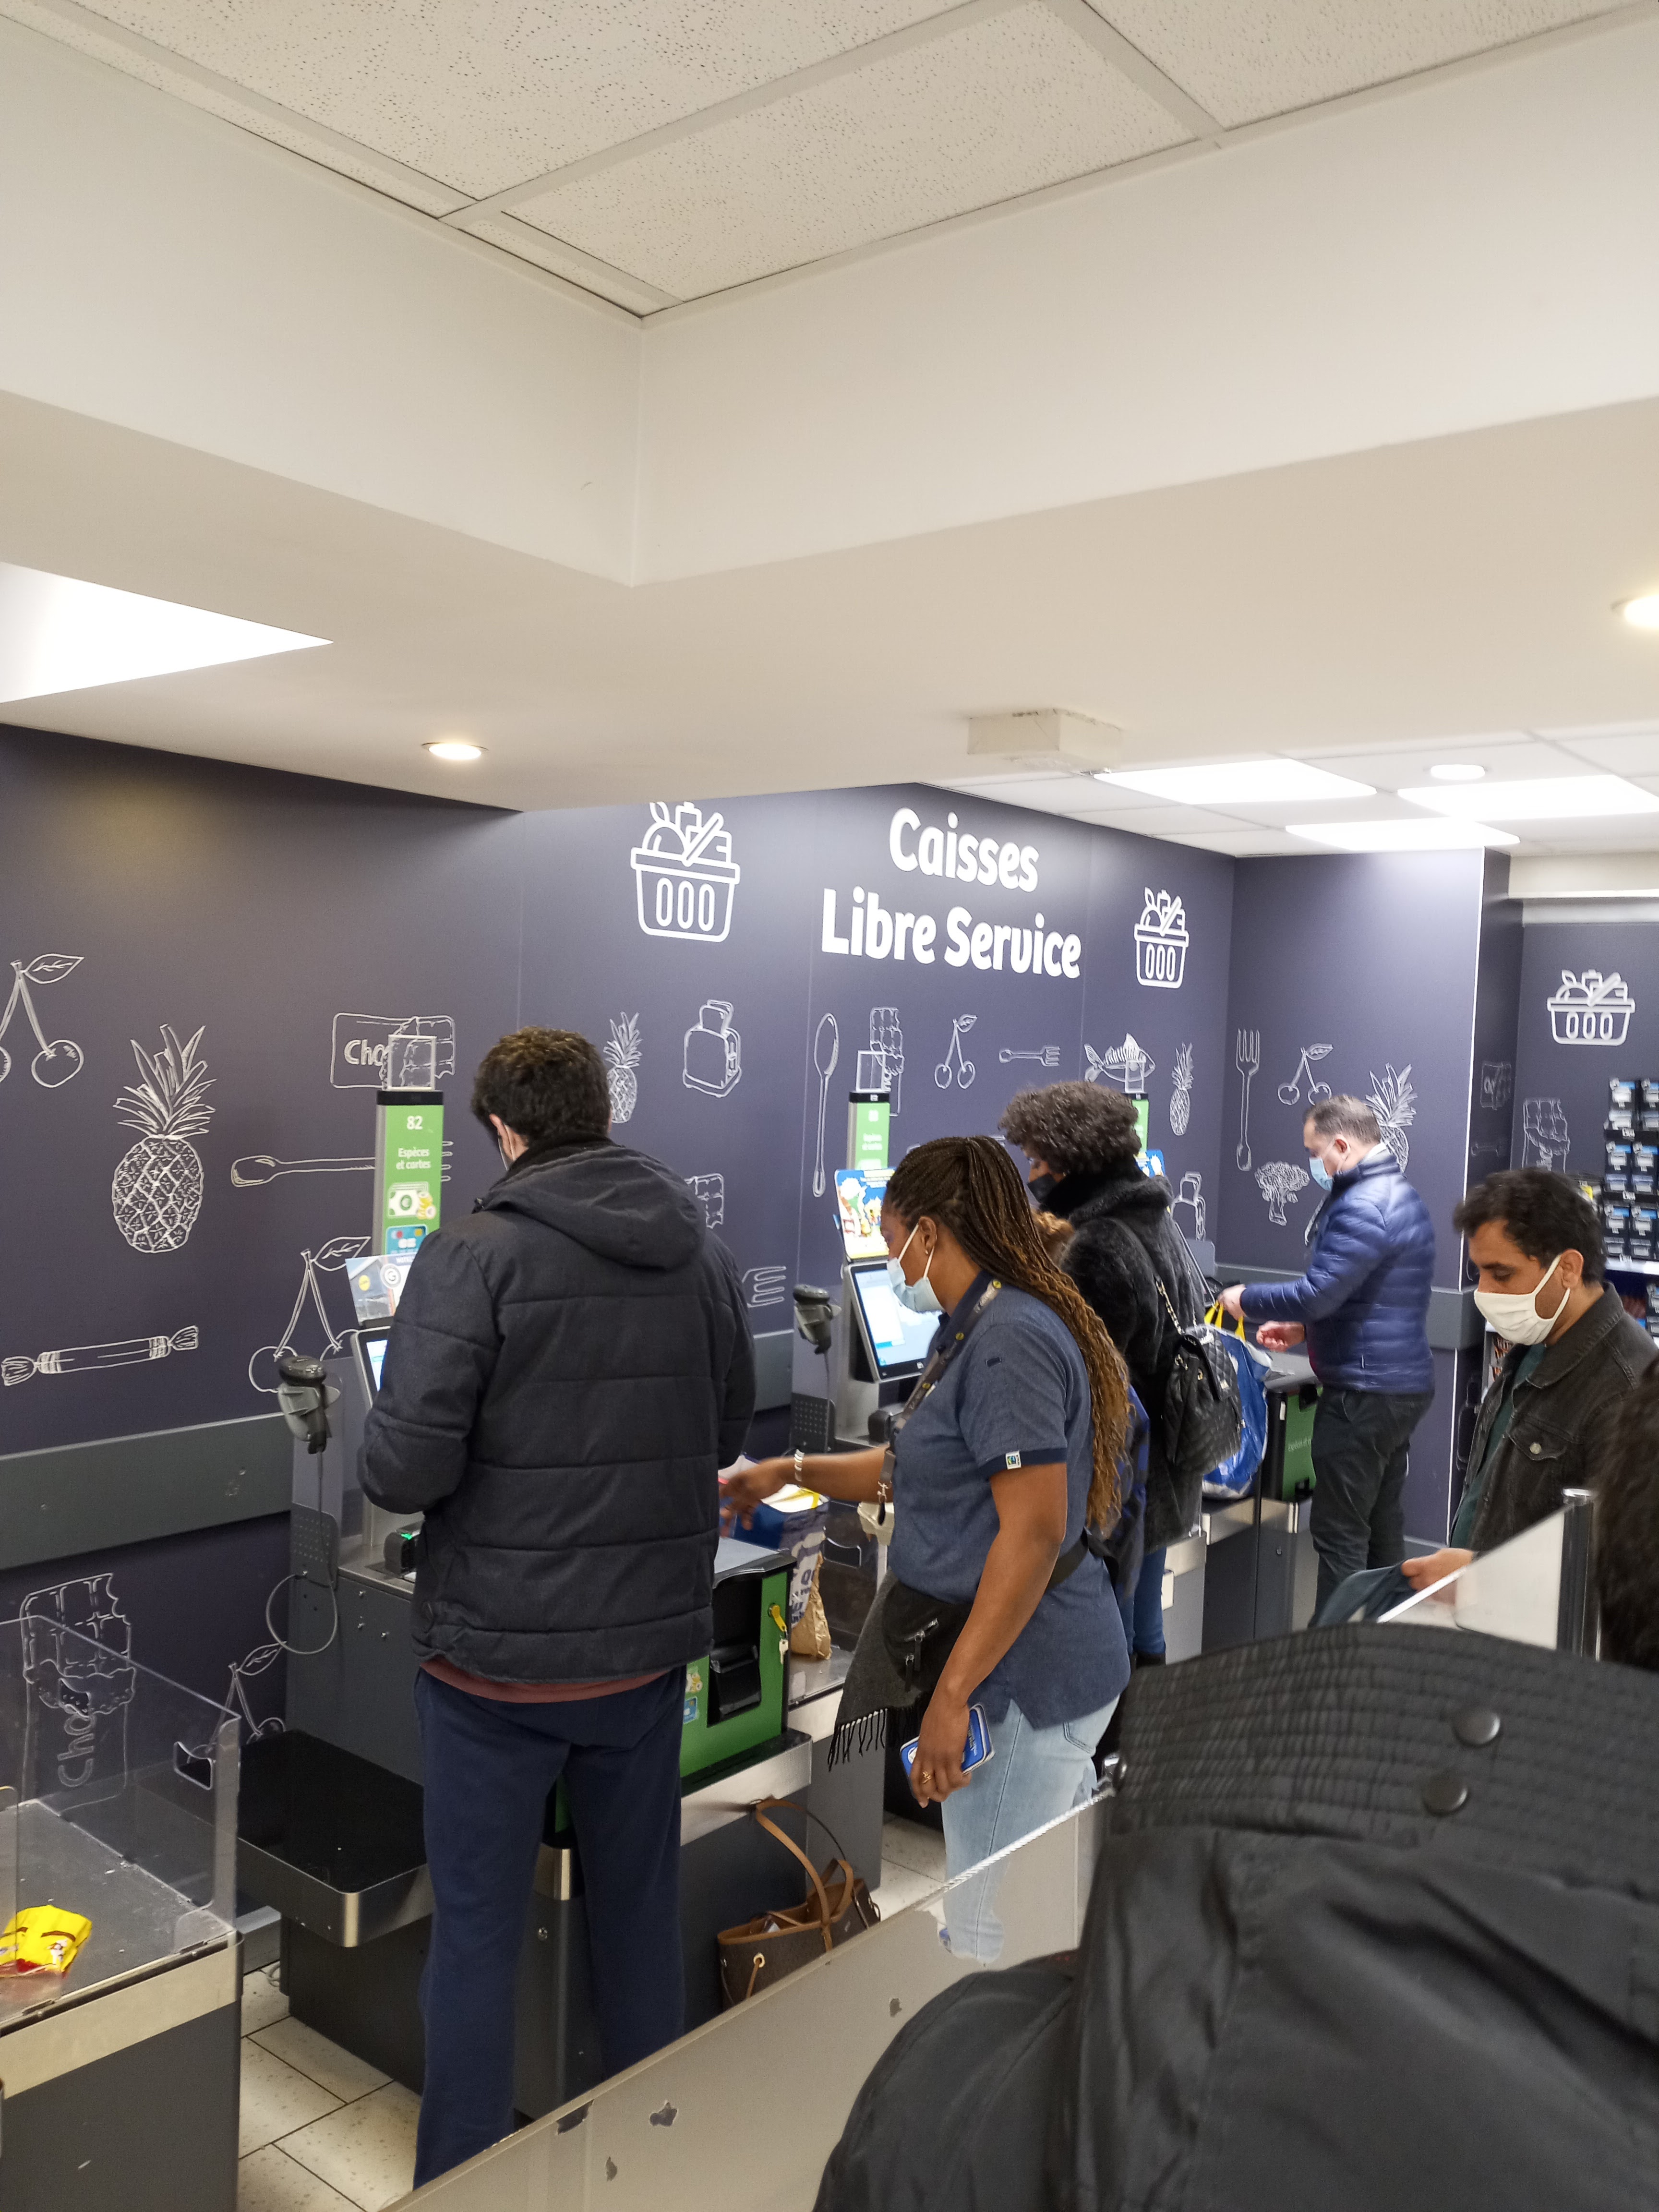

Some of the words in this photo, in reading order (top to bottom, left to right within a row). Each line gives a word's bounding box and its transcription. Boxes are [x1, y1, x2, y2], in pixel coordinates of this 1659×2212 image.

[890, 807, 1039, 892] Caisses
[822, 886, 937, 964] Libre
[944, 906, 1082, 979] Service
[407, 1115, 423, 1130] 82
[398, 1146, 430, 1159] Espèces
[406, 1159, 431, 1169] cartes
